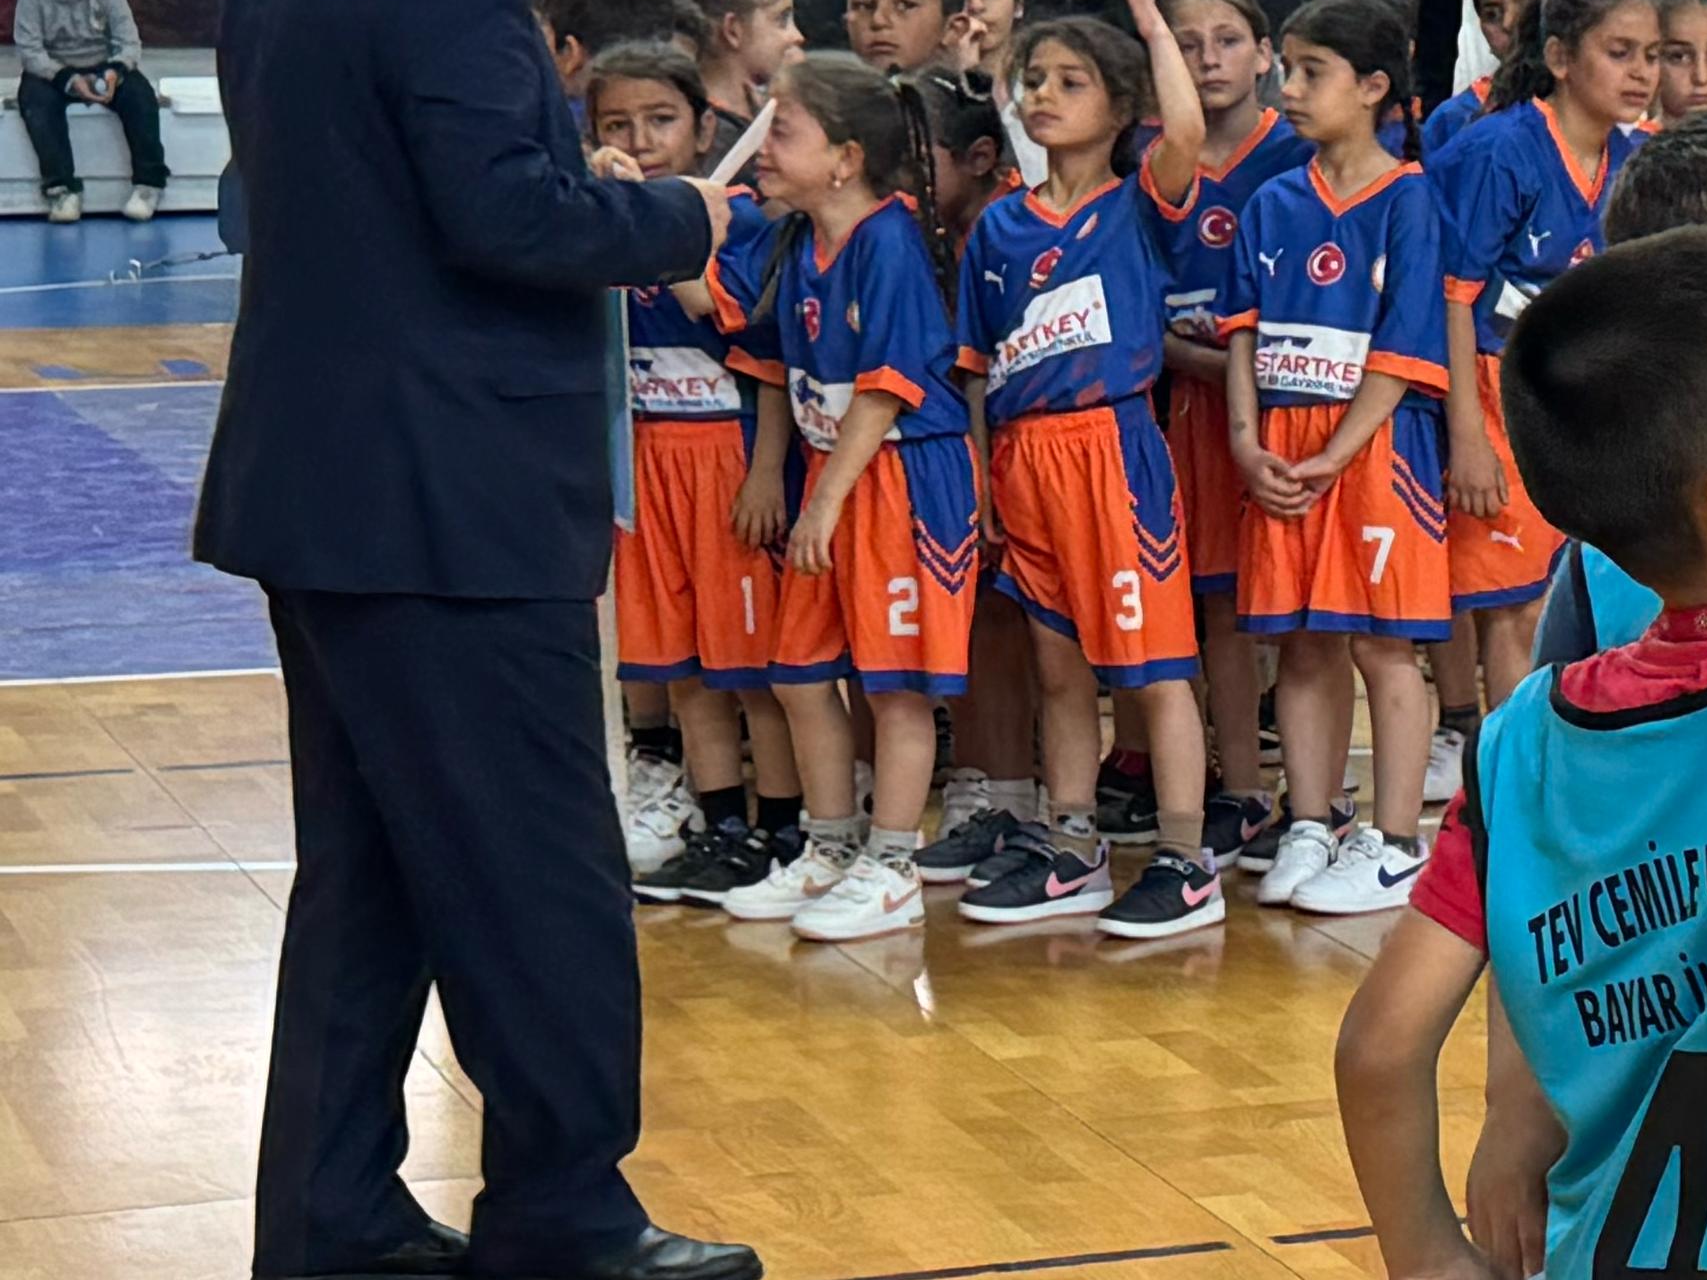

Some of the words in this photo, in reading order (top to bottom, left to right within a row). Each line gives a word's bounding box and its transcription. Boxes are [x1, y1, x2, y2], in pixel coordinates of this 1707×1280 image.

[1256, 352, 1360, 383] STARTKE
[1362, 526, 1396, 585] 7
[740, 576, 756, 635] 1
[886, 577, 921, 637] 2
[1112, 570, 1144, 631] 3
[1528, 893, 1585, 984] TEV
[1574, 971, 1692, 1048] BAYAR
